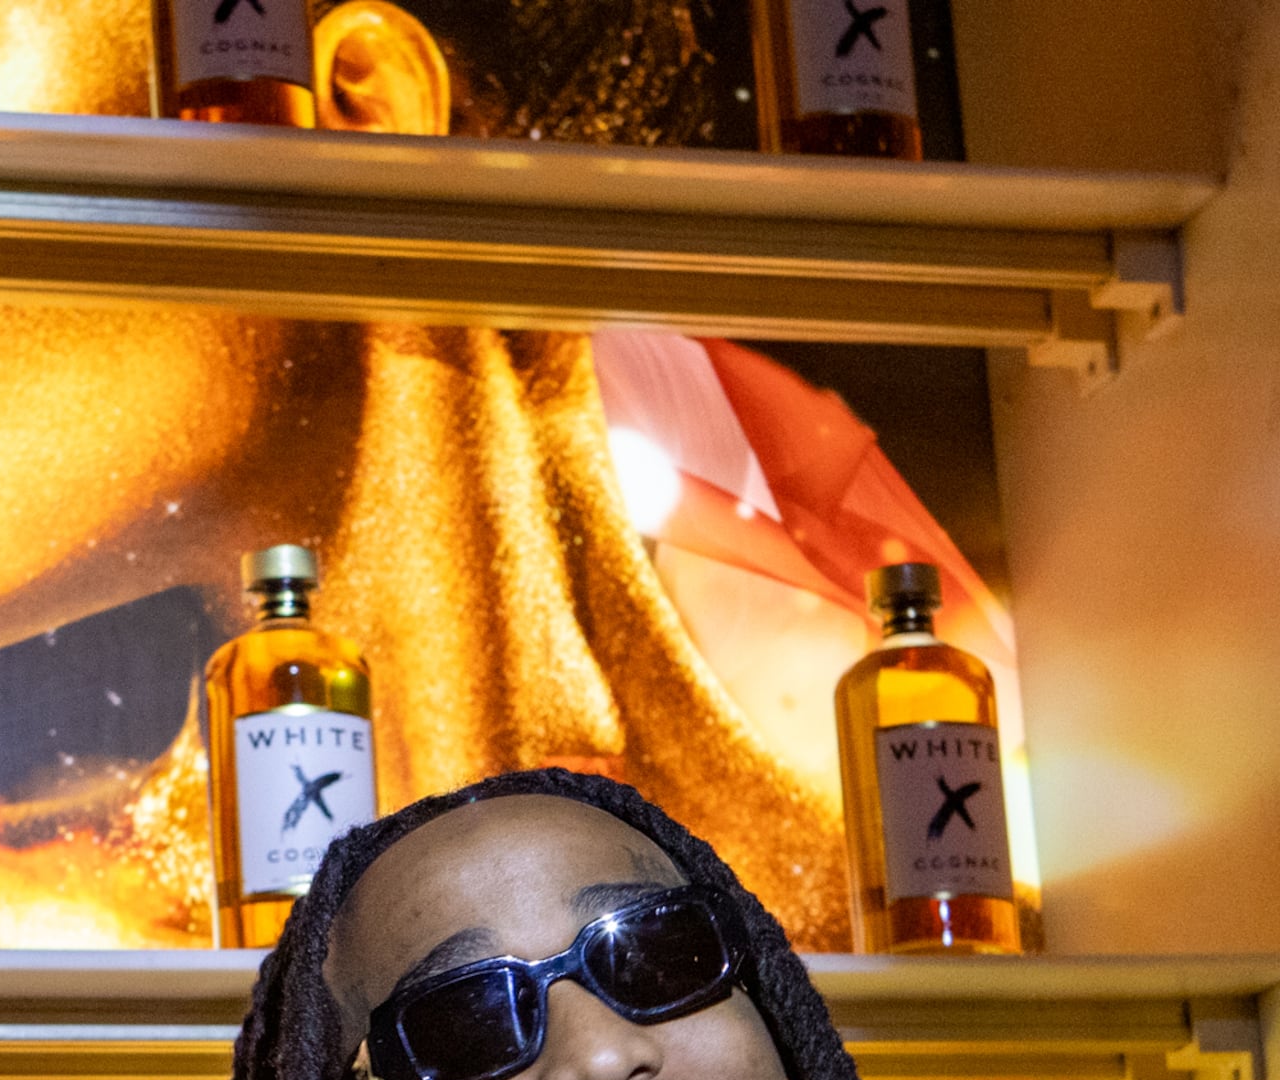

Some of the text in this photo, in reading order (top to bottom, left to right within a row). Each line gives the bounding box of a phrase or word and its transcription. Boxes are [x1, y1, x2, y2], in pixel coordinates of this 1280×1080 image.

[248, 727, 365, 751] WHITE
[890, 740, 997, 762] WHITE
[280, 760, 349, 839] X
[926, 774, 982, 843] X
